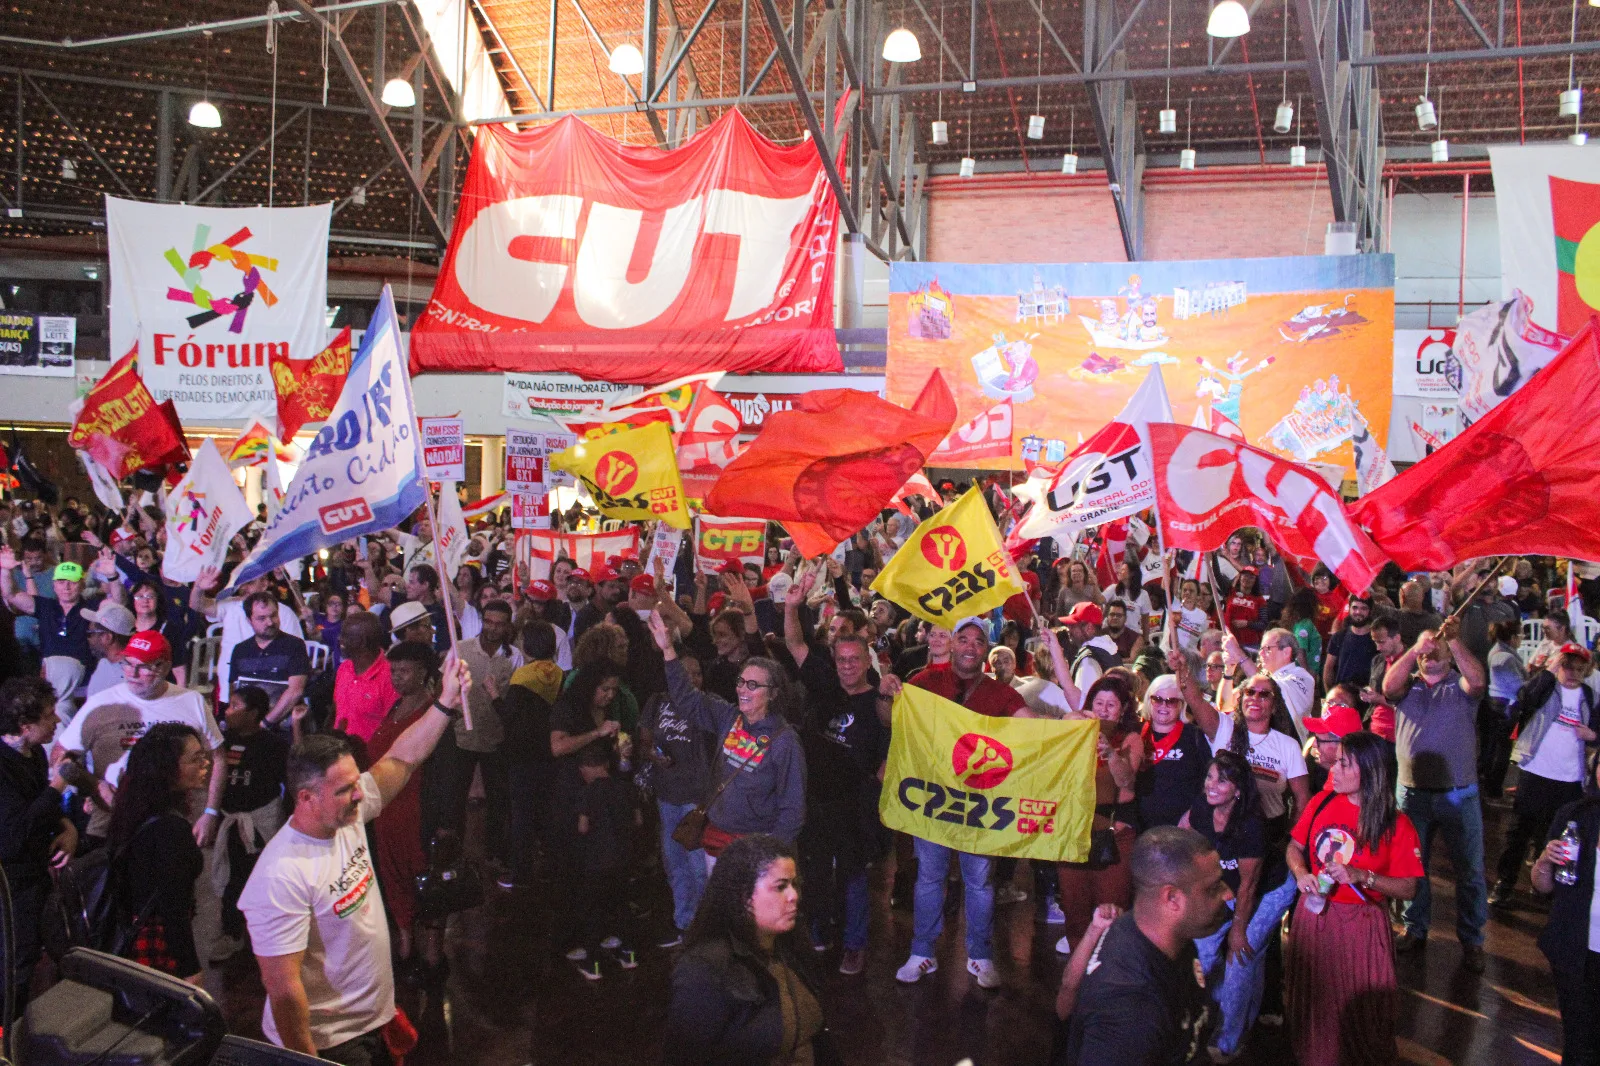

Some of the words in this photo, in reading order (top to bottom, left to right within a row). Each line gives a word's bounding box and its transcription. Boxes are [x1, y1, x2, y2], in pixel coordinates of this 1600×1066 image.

[455, 187, 818, 329] CUT
[153, 333, 290, 369] Fórum
[179, 373, 209, 386] PELOS
[211, 373, 254, 387] DIREITOS
[255, 373, 264, 385] &
[533, 380, 554, 392] NÃO
[556, 383, 573, 392] TEM
[574, 383, 599, 393] HORA
[154, 389, 214, 403] LIBERDADES
[513, 434, 537, 446] REDUÇÃO
[427, 448, 444, 464] NÃO
[517, 447, 541, 456] JORNADA
[512, 456, 525, 468] FIM
[526, 457, 537, 470] DA
[516, 469, 532, 481] 6X1
[1047, 446, 1141, 511] UGT
[650, 488, 675, 500] CUT
[1089, 490, 1127, 507] GERAL
[325, 504, 366, 525] CUT
[1170, 512, 1218, 532] CENTRAL
[703, 528, 761, 552] CTB
[918, 562, 995, 616] CPERS
[899, 779, 1016, 832] CPERS
[1019, 799, 1056, 816] CUT
